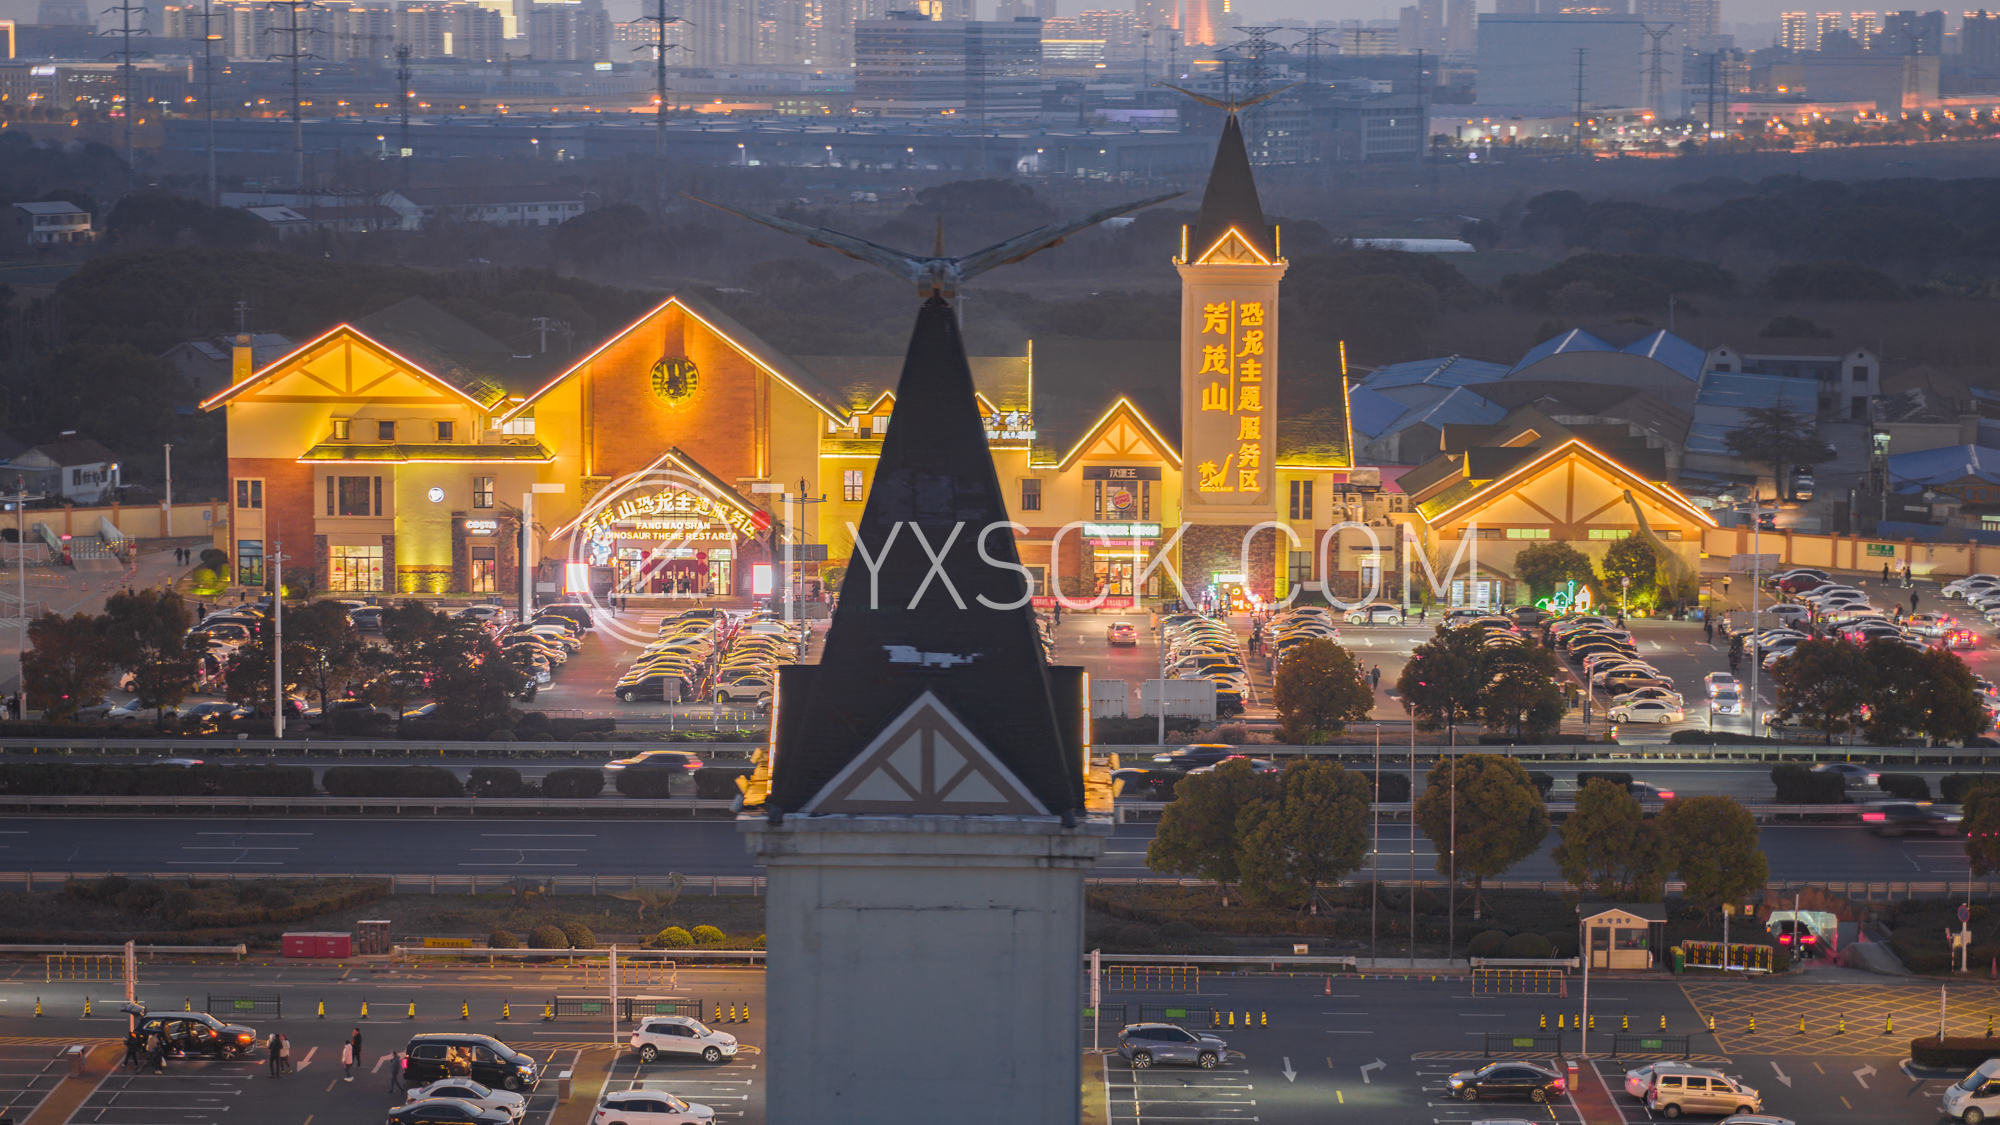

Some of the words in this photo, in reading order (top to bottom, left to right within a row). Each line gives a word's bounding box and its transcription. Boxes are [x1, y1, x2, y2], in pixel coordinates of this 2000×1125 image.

[1199, 302, 1230, 412] 芳茂山
[1235, 302, 1265, 492] 恐龙主题服务区
[1109, 468, 1137, 479] 汉堡王
[636, 521, 661, 530] FANG
[662, 521, 684, 530] MAO
[685, 521, 710, 530] SHAN
[605, 532, 652, 540] DINOSAUR
[652, 532, 684, 540] THEME
[685, 532, 711, 540] REST
[711, 532, 738, 540] AREA
